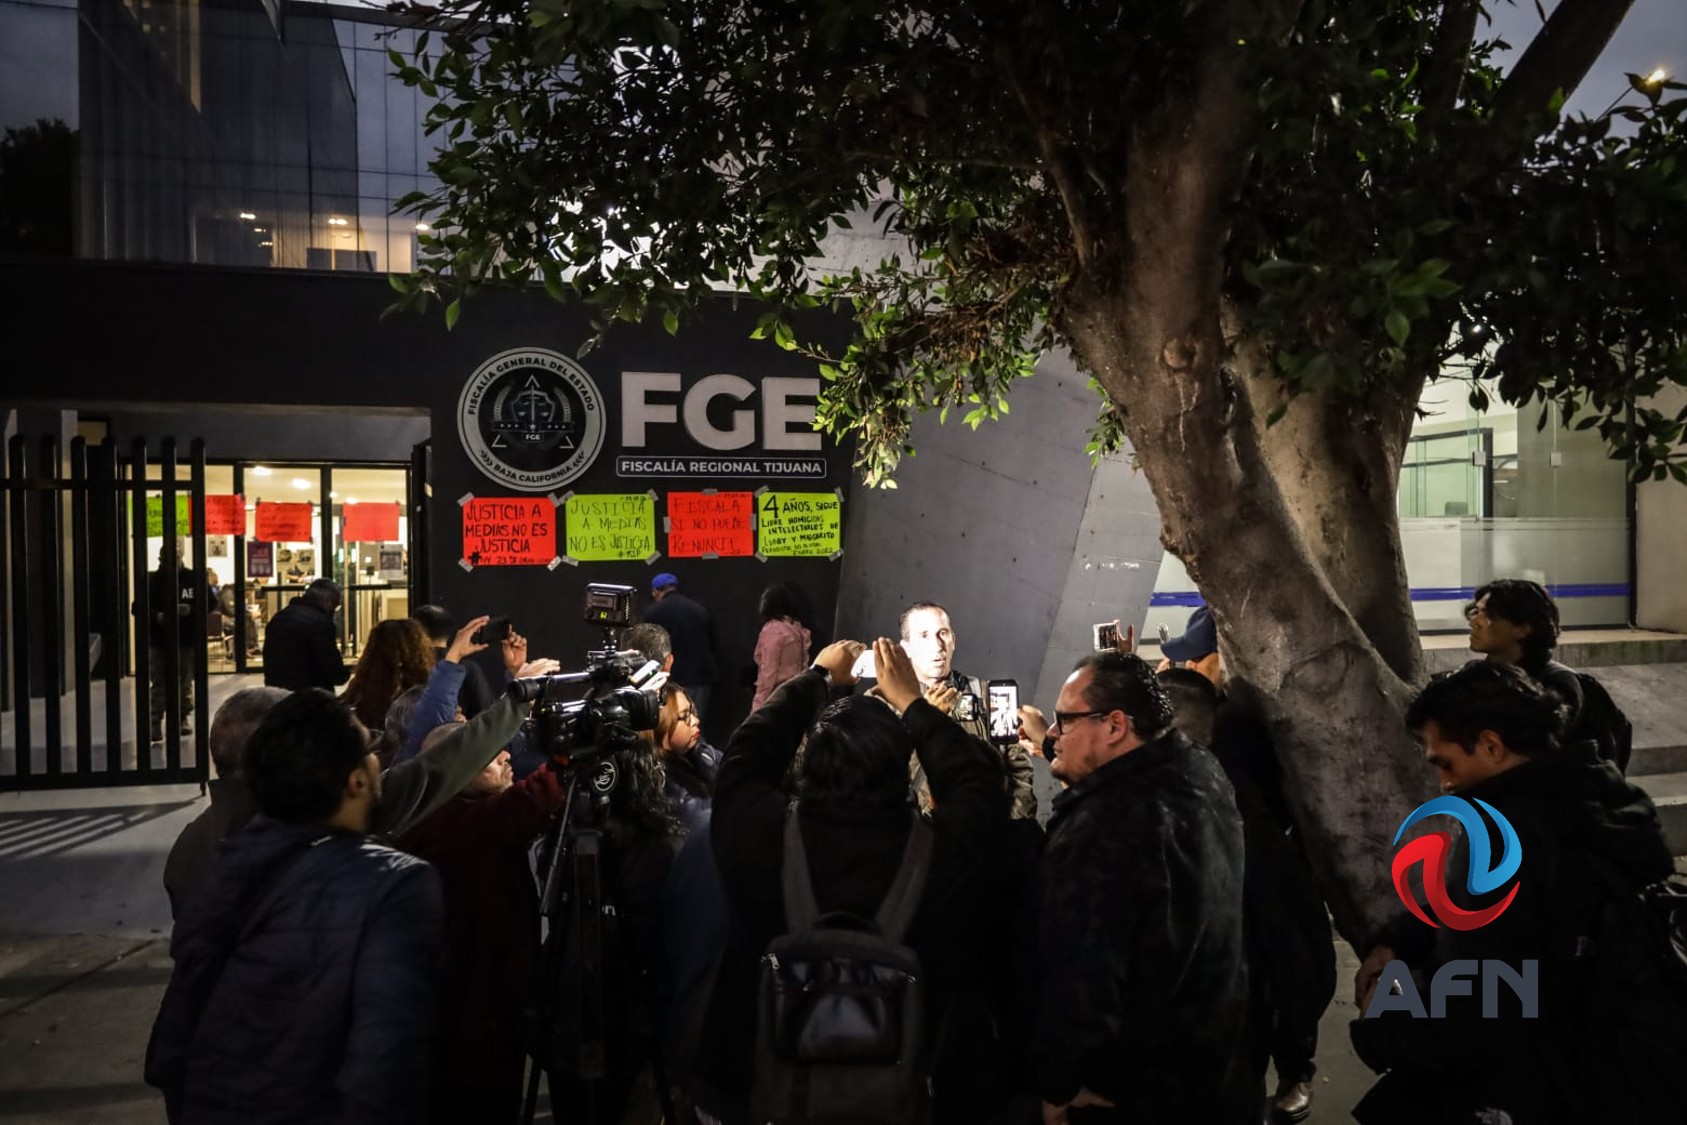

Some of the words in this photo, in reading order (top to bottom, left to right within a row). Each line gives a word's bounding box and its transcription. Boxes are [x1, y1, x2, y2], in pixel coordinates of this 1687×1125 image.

[468, 369, 496, 415] FISCALÍA
[497, 357, 546, 373] GENERAL
[549, 361, 570, 377] DEL
[569, 374, 595, 412] ESTADO
[621, 372, 822, 451] FGE
[494, 465, 517, 481] BAJA
[519, 466, 572, 483] CALIFORNIA
[622, 459, 686, 473] FISCALÍA
[690, 461, 761, 473] REGIONAL
[764, 462, 822, 474] TIJUANA
[467, 503, 525, 521] JUSTICIA
[531, 503, 542, 517] A
[571, 499, 645, 516] JUSTICIA
[762, 494, 779, 519] 4
[816, 501, 838, 511] SIGUE
[465, 524, 509, 537] MEDIAS
[512, 524, 527, 536] NO
[532, 523, 549, 536] ES
[582, 517, 590, 531] A
[599, 516, 646, 532] MEDIAS
[693, 518, 707, 529] NO
[475, 538, 531, 554] JUSTICIA
[570, 536, 588, 552] NO
[591, 535, 606, 551] ES
[610, 534, 650, 551] JUSTICIA
